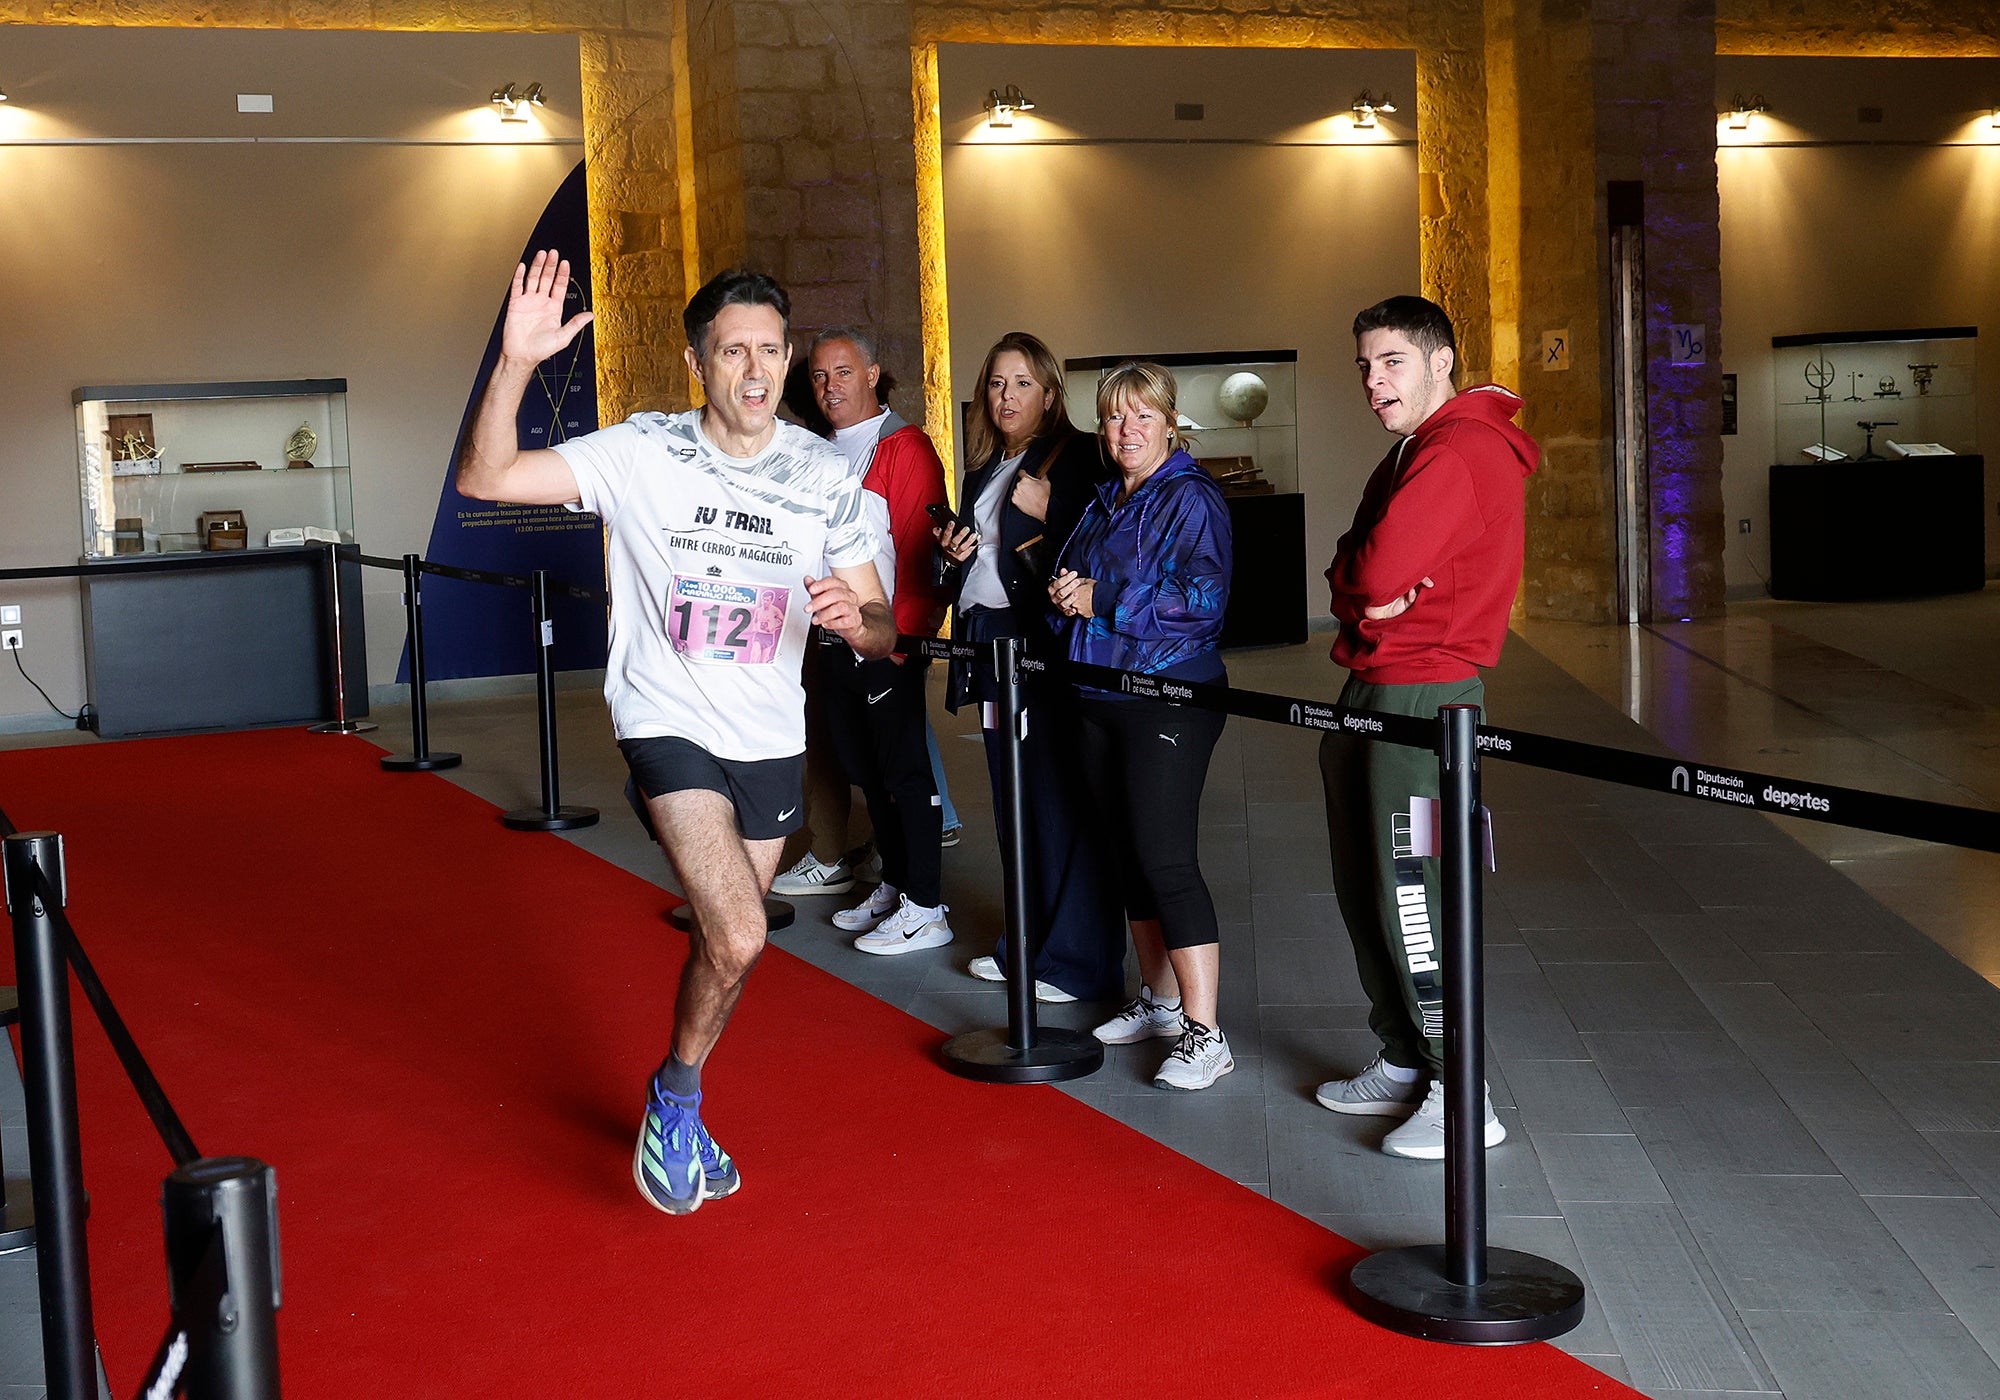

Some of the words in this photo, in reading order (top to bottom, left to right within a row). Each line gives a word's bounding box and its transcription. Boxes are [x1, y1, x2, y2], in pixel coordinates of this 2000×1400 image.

[462, 520, 494, 528] proyectado
[725, 510, 774, 536] TRAIL
[670, 536, 698, 552] ENTRE
[702, 541, 736, 557] CERROS
[738, 548, 793, 566] MAGACEÑOS
[697, 582, 736, 594] 10.000
[674, 601, 752, 648] 112
[952, 644, 976, 658] deportes
[1020, 656, 1045, 671] deportes
[1132, 676, 1154, 686] Diputación
[1140, 686, 1160, 696] PALENCIA
[1162, 682, 1192, 698] deportes
[1304, 705, 1333, 718] Diputación
[1305, 718, 1312, 726] DE
[1314, 718, 1340, 730] PALENCIA
[1344, 714, 1382, 732] deportes
[1476, 735, 1512, 752] portes
[1697, 770, 1744, 788] Diputación
[1696, 784, 1709, 796] DE
[1710, 787, 1754, 805] PALENCIA
[1762, 785, 1830, 812] deportes
[1396, 884, 1440, 974] PUMA
